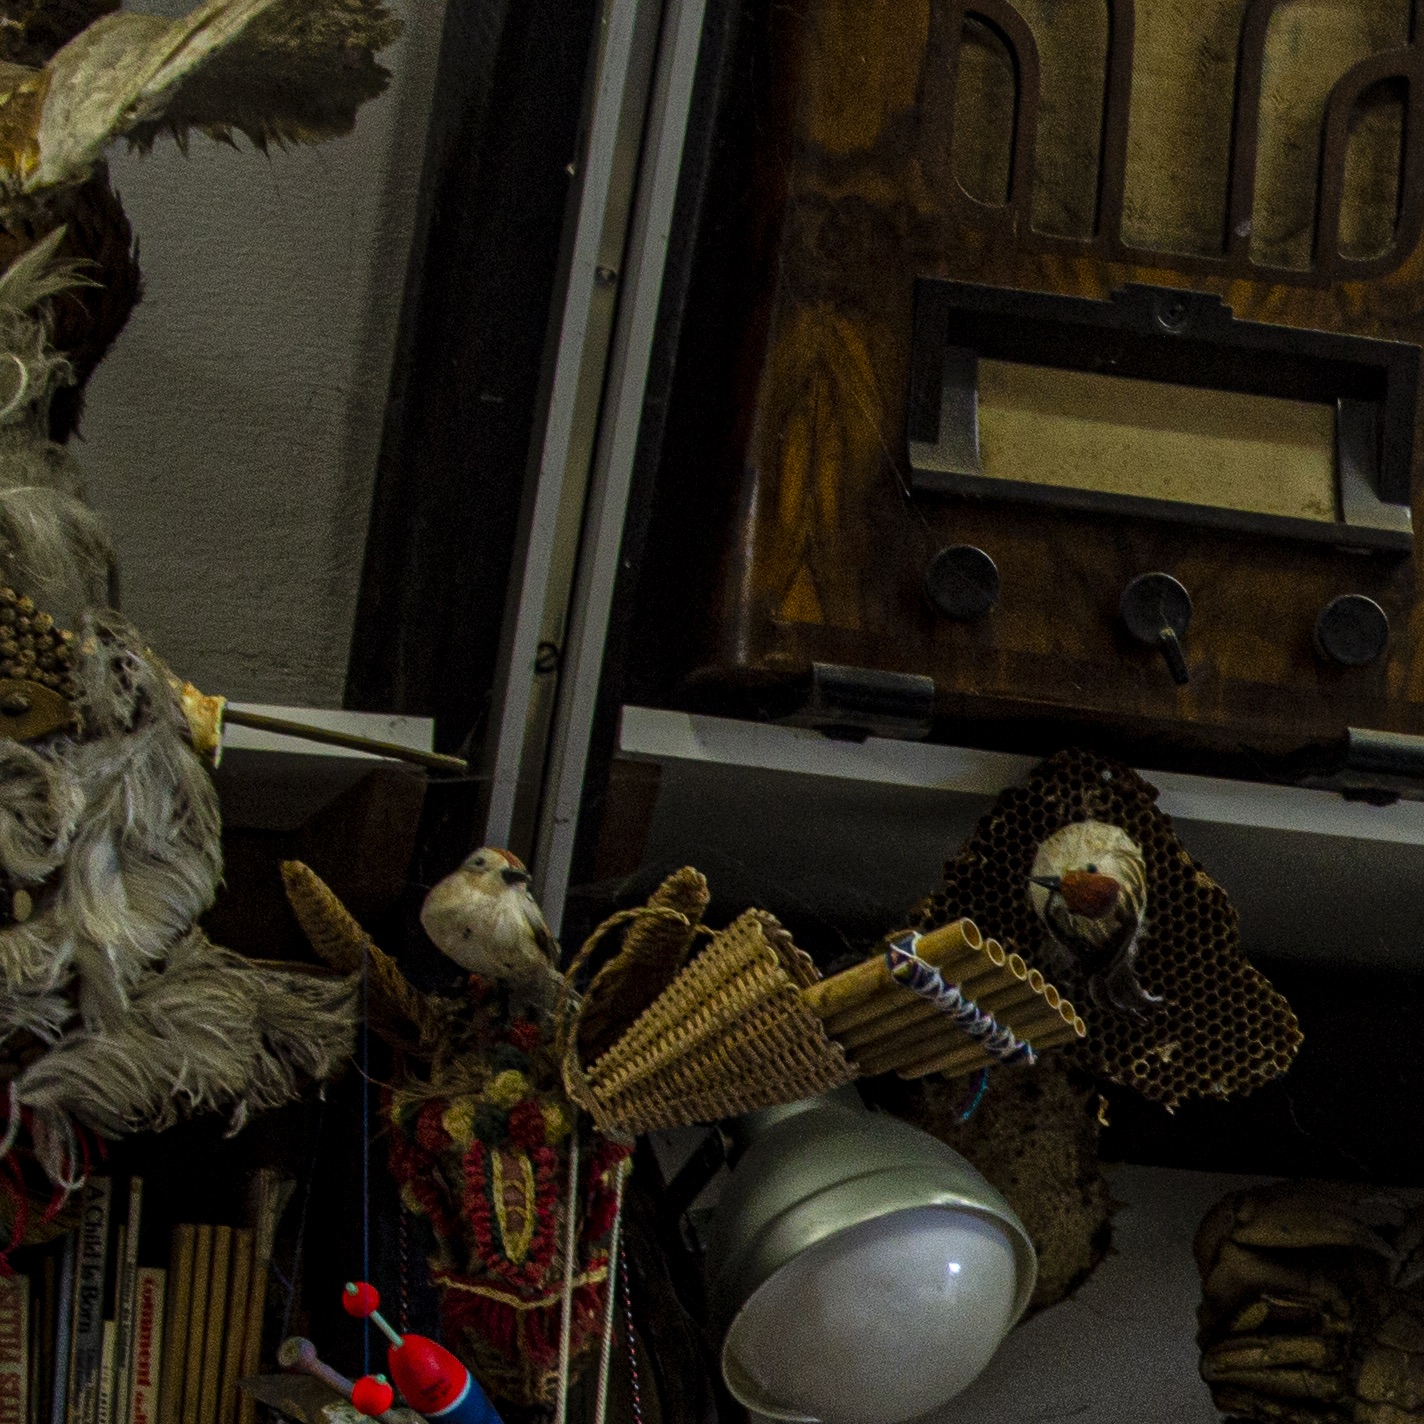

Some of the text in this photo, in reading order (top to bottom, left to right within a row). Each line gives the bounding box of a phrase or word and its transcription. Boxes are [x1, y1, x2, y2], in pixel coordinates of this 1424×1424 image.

[85, 1186, 105, 1202] A
[83, 1206, 104, 1259] Child
[79, 1264, 100, 1281] Is
[77, 1286, 99, 1334] Born
